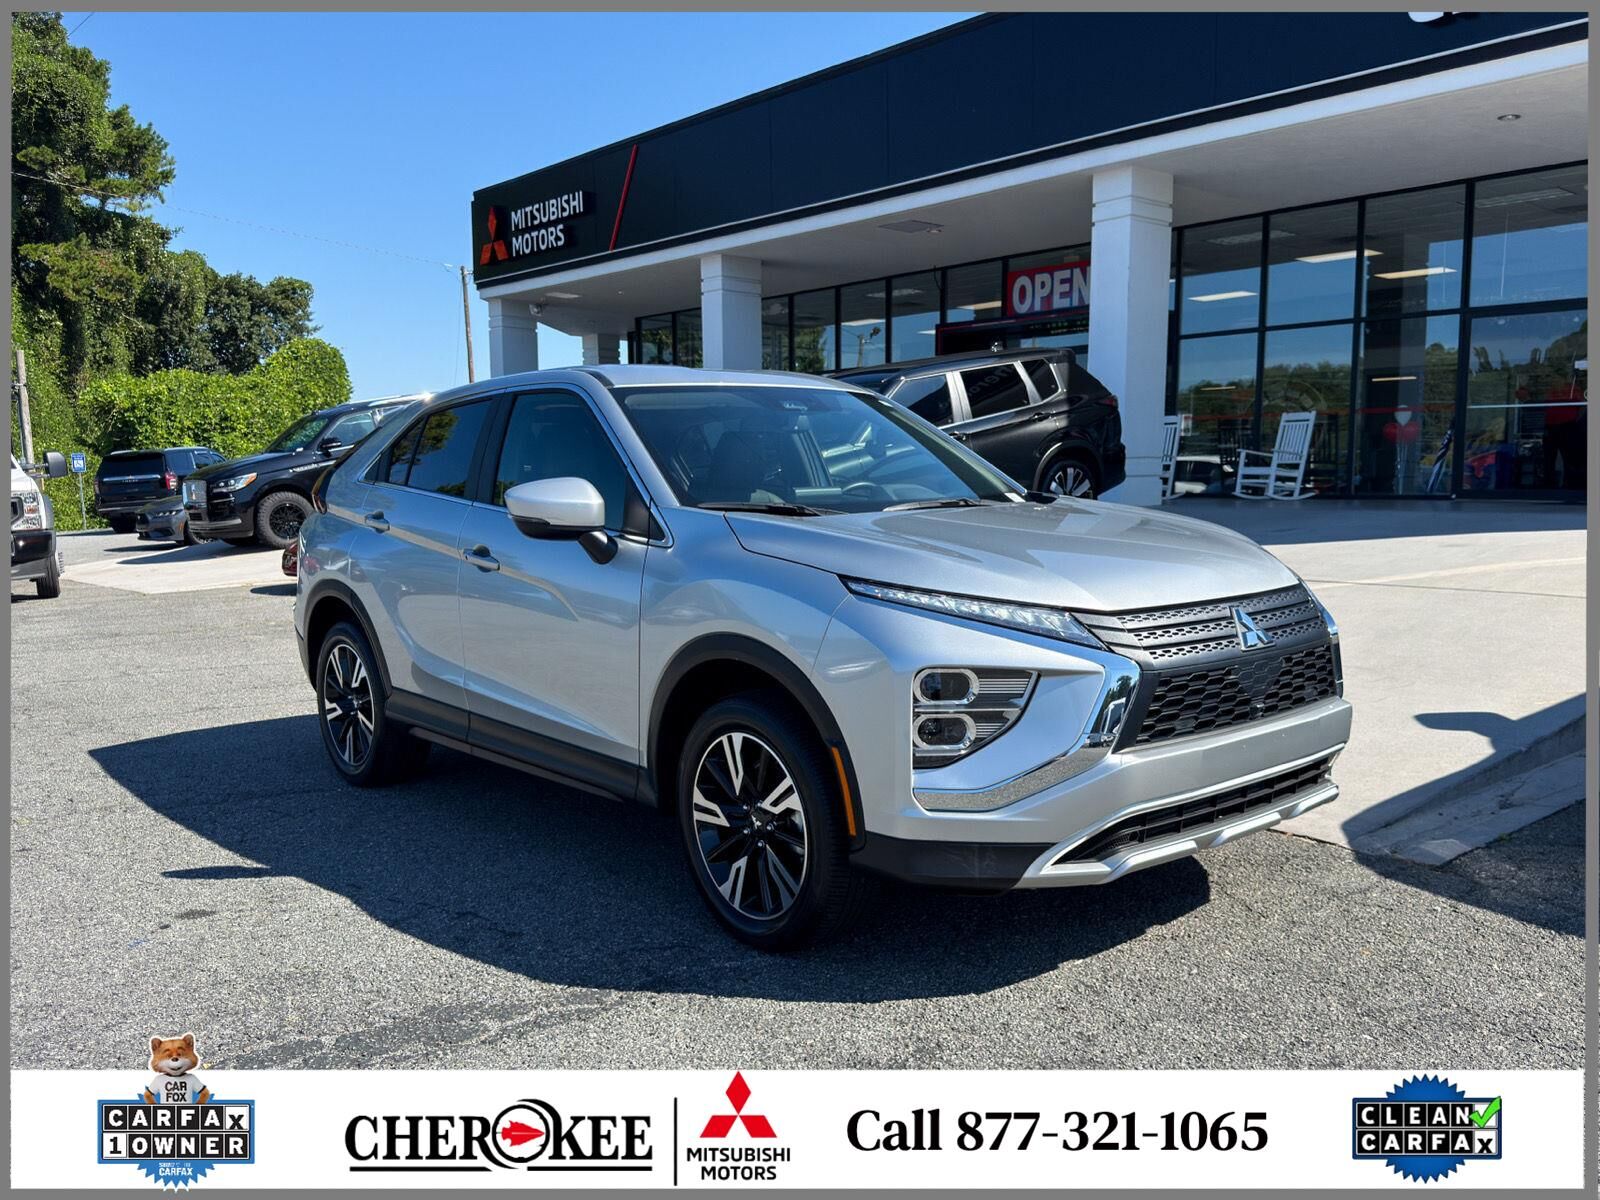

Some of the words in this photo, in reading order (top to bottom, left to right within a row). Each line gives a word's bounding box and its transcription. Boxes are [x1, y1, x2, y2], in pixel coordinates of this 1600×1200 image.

[511, 190, 584, 231] MITSUBISHI
[512, 224, 565, 257] MOTORS
[1012, 266, 1090, 314] OPEN
